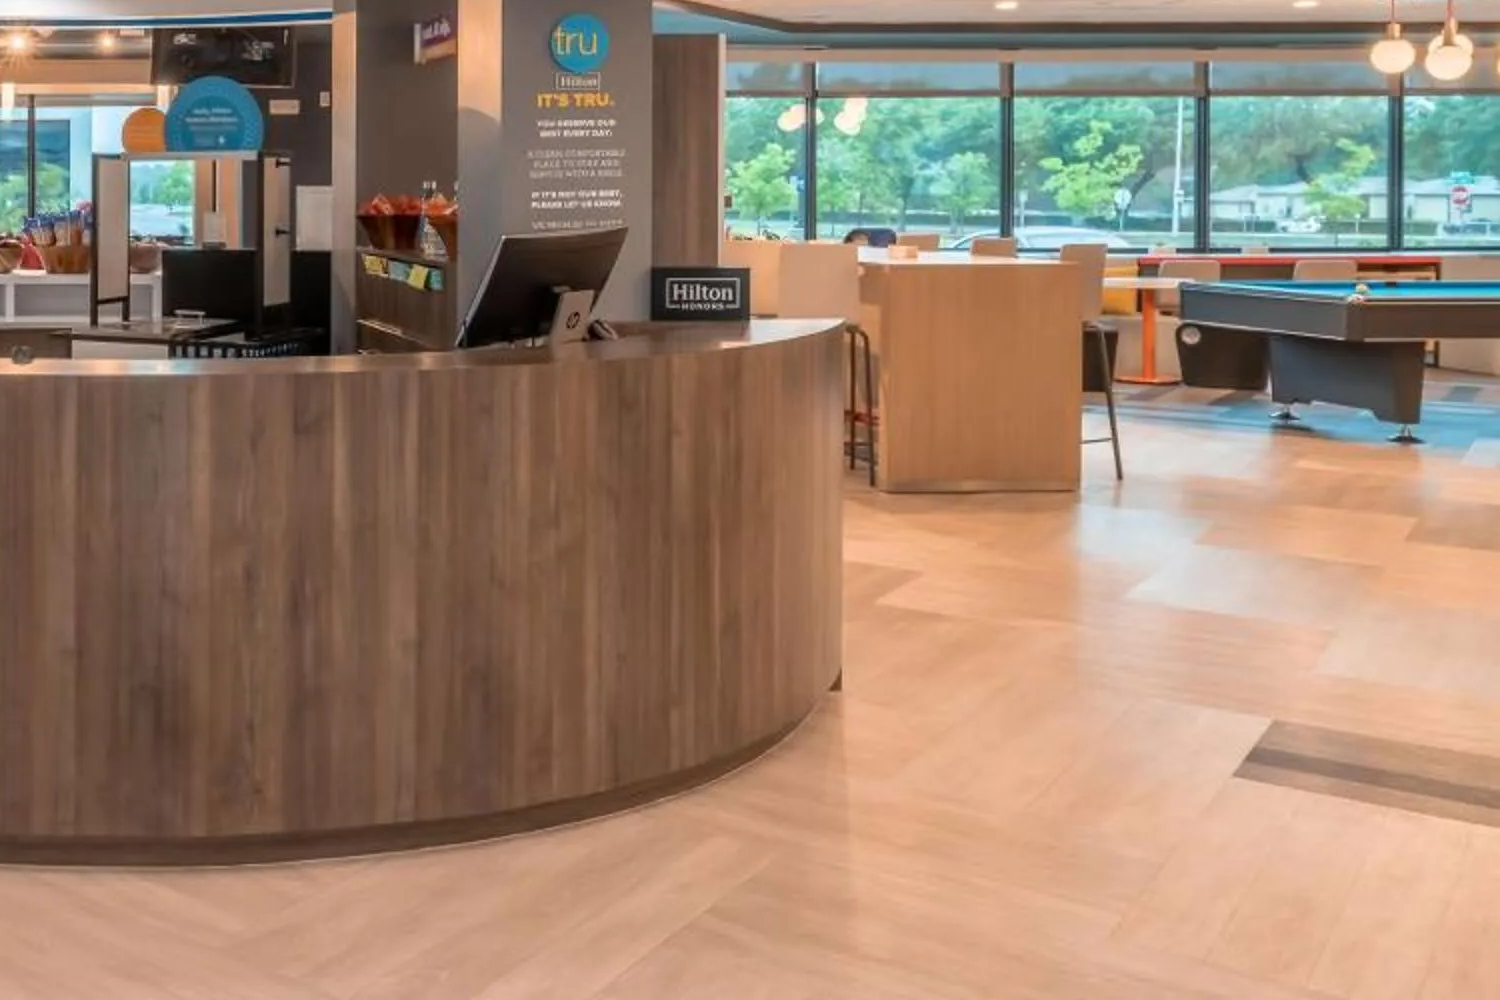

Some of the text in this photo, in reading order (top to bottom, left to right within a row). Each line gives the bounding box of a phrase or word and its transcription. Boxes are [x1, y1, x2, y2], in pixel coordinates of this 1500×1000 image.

[551, 26, 597, 55] tru
[537, 92, 615, 108] IT'S TRU.
[672, 283, 733, 301] Hilton
